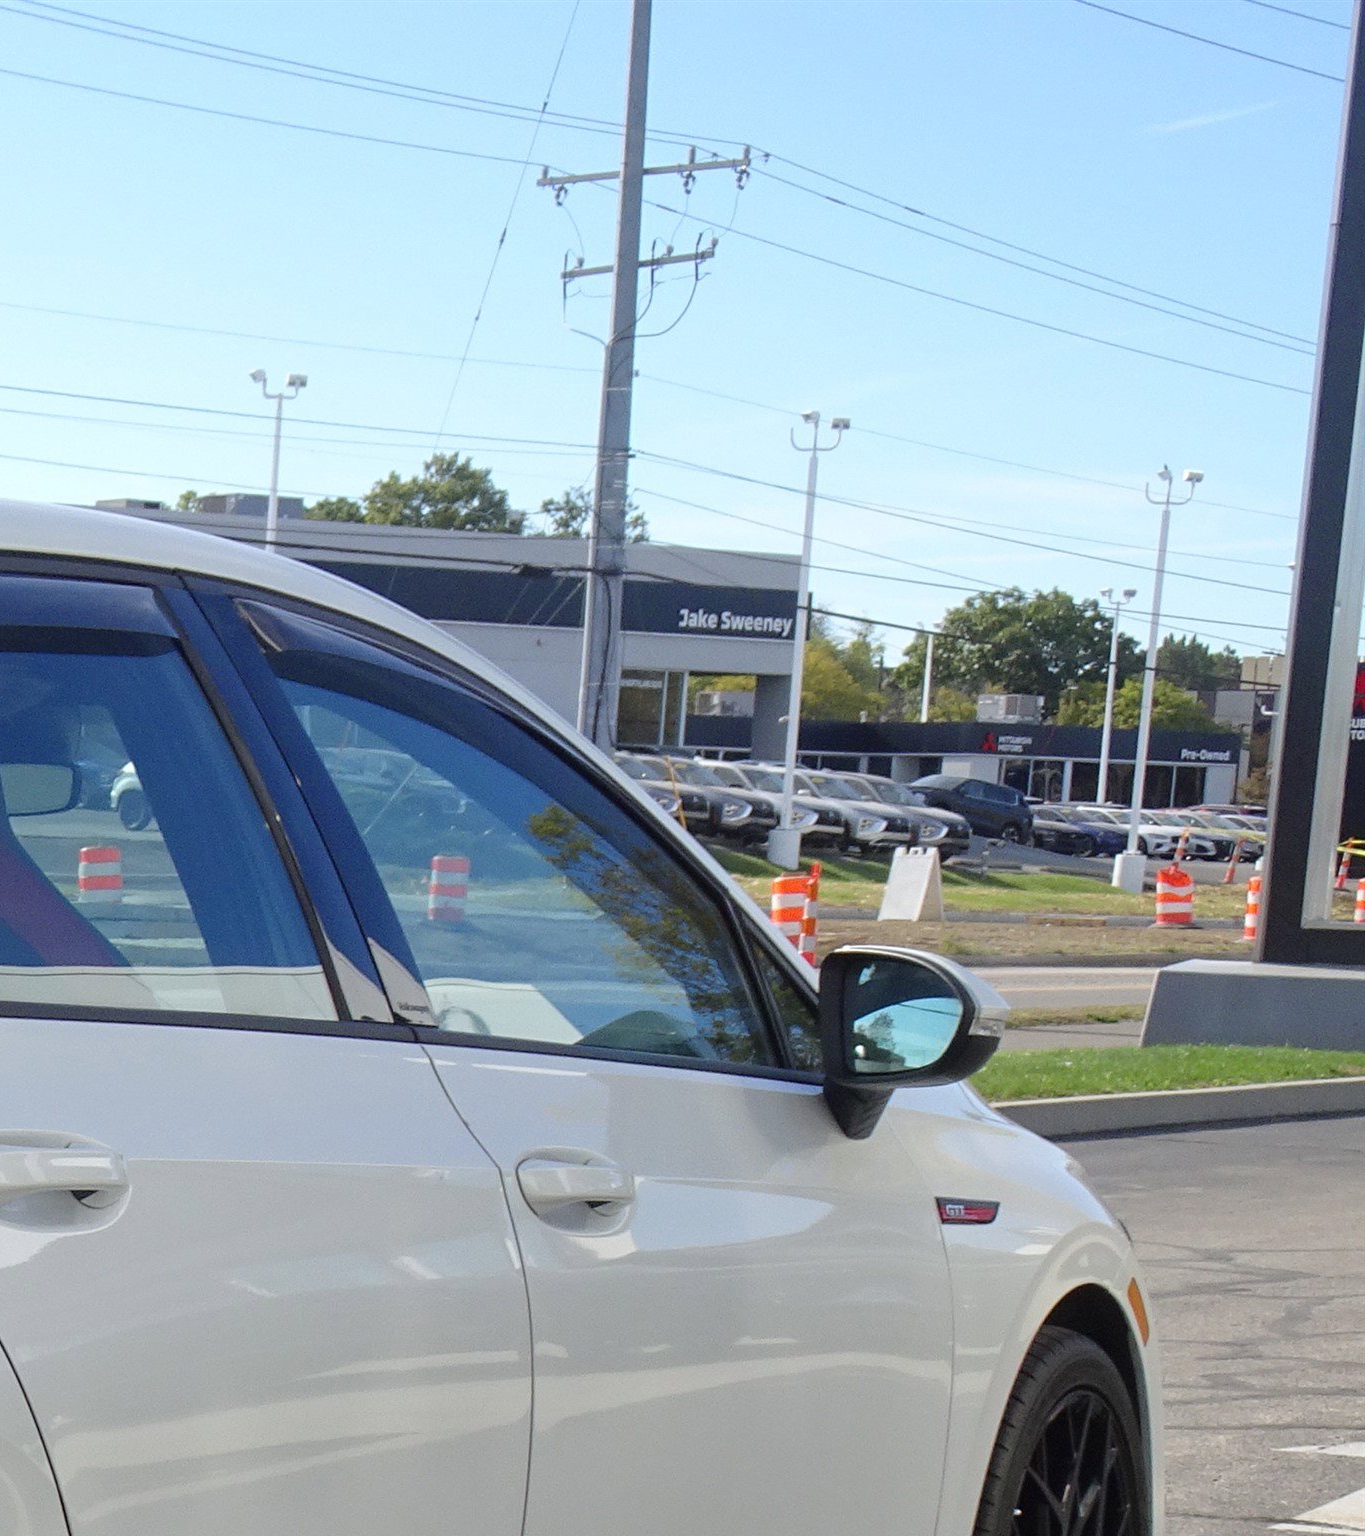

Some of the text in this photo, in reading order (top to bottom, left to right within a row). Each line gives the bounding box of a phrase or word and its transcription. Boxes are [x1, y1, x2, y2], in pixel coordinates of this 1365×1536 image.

[678, 608, 794, 637] Jake Sweeney
[1181, 748, 1231, 761] Pre-Owned
